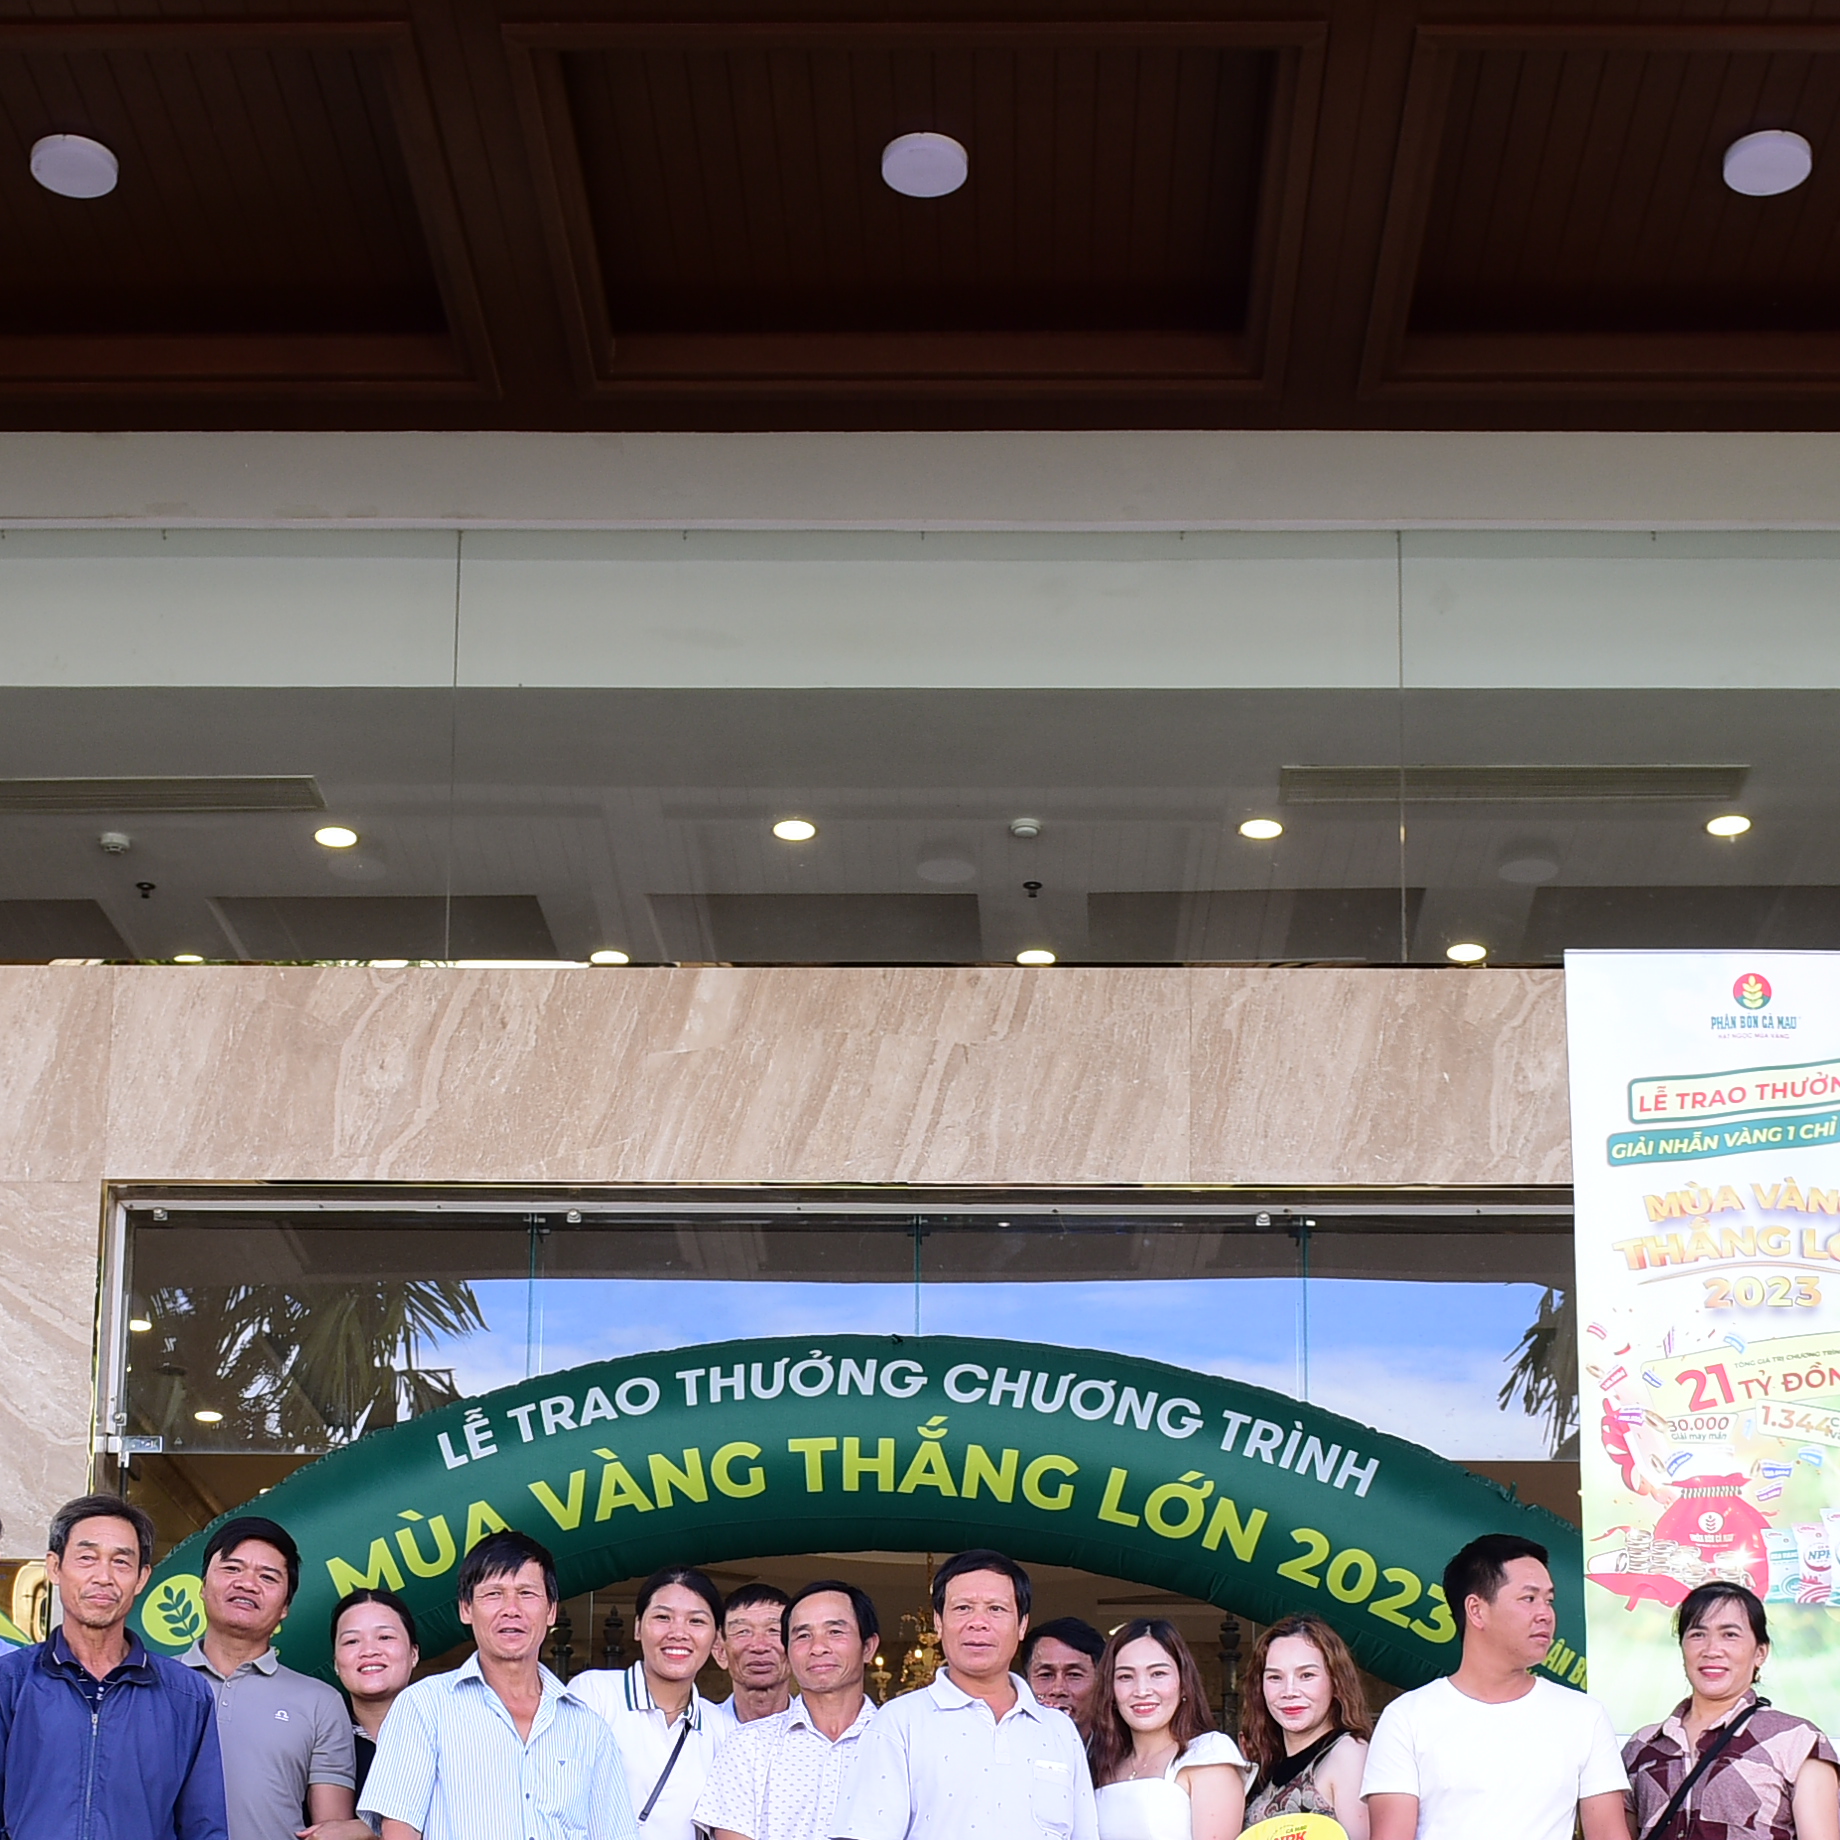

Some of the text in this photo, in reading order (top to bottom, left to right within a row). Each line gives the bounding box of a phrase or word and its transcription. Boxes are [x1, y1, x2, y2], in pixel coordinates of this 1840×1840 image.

[1639, 1086, 1668, 1112] LỄ
[1677, 1087, 1746, 1109] TRAO
[1612, 1136, 1654, 1159] GIẢI
[1659, 1132, 1718, 1153] NHẪN
[1723, 1126, 1781, 1147] VÀNG
[1787, 1126, 1794, 1141] 1
[1643, 1182, 1745, 1222] MÙA
[1613, 1217, 1790, 1270] THẮNG
[1703, 1276, 1822, 1308] 2023
[1675, 1363, 1735, 1412] 21
[1738, 1370, 1771, 1399] TỶ
[437, 1349, 1381, 1498] LỄ TRAO THƯỞNG CHƯƠNG TRÌNH
[1668, 1417, 1729, 1432] 30.000
[1761, 1406, 1831, 1436] 1.344
[527, 1446, 766, 1531] VÀNG
[788, 1415, 1079, 1512] THẮNG
[1097, 1470, 1268, 1563] LỚN
[1277, 1527, 1458, 1644] 2023
